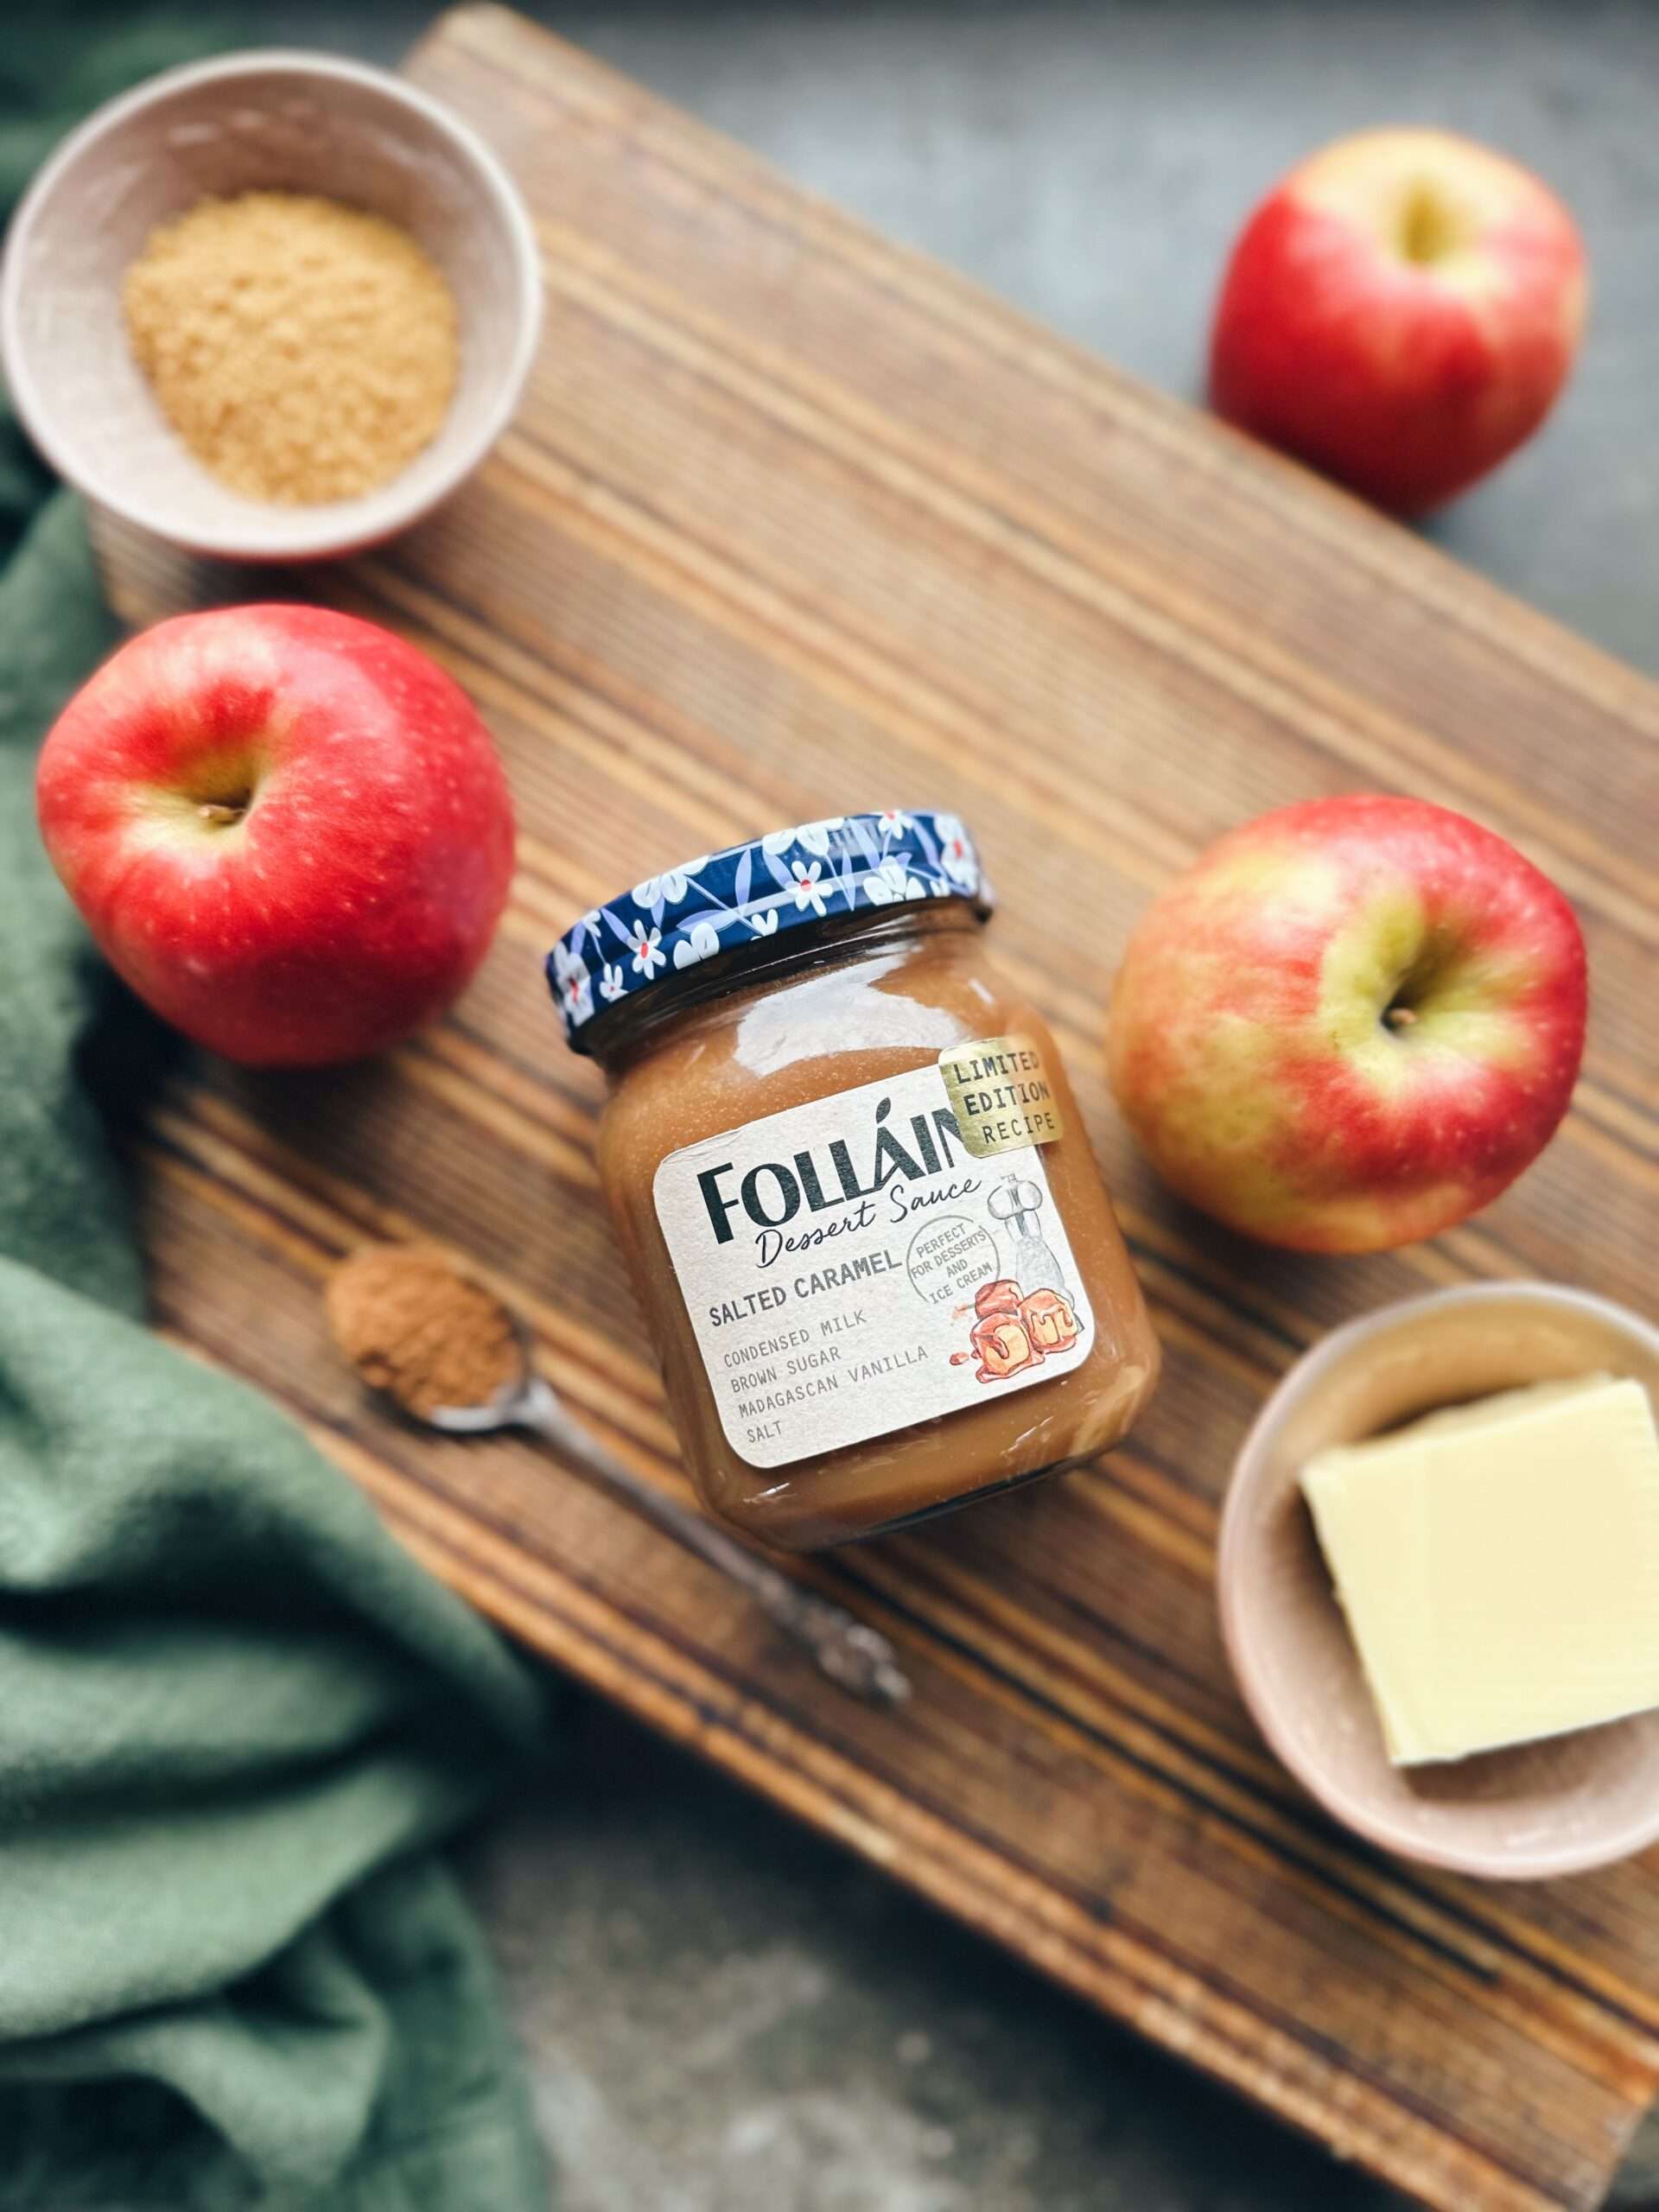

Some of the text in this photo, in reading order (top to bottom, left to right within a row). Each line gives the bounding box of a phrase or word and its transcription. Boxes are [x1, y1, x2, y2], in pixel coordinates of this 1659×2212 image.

[954, 1050, 1040, 1083] LIMITED
[964, 1082, 1050, 1115] EDITION
[982, 1113, 1055, 1143] RECIPE
[755, 1177, 982, 1268] Dessert Sauce
[917, 1223, 966, 1258] PERFECT
[911, 1230, 987, 1279] FOR DESSERTS
[946, 1259, 968, 1277] AND
[709, 1249, 902, 1326] SALTED CARAMEL
[930, 1262, 993, 1305] ICE CREAM
[724, 1310, 867, 1368] CONDENSED MILK
[731, 1346, 841, 1394] BROWN SUGAR
[739, 1346, 929, 1417] MADAGASCAN VANILLA
[747, 1421, 784, 1443] SALT
